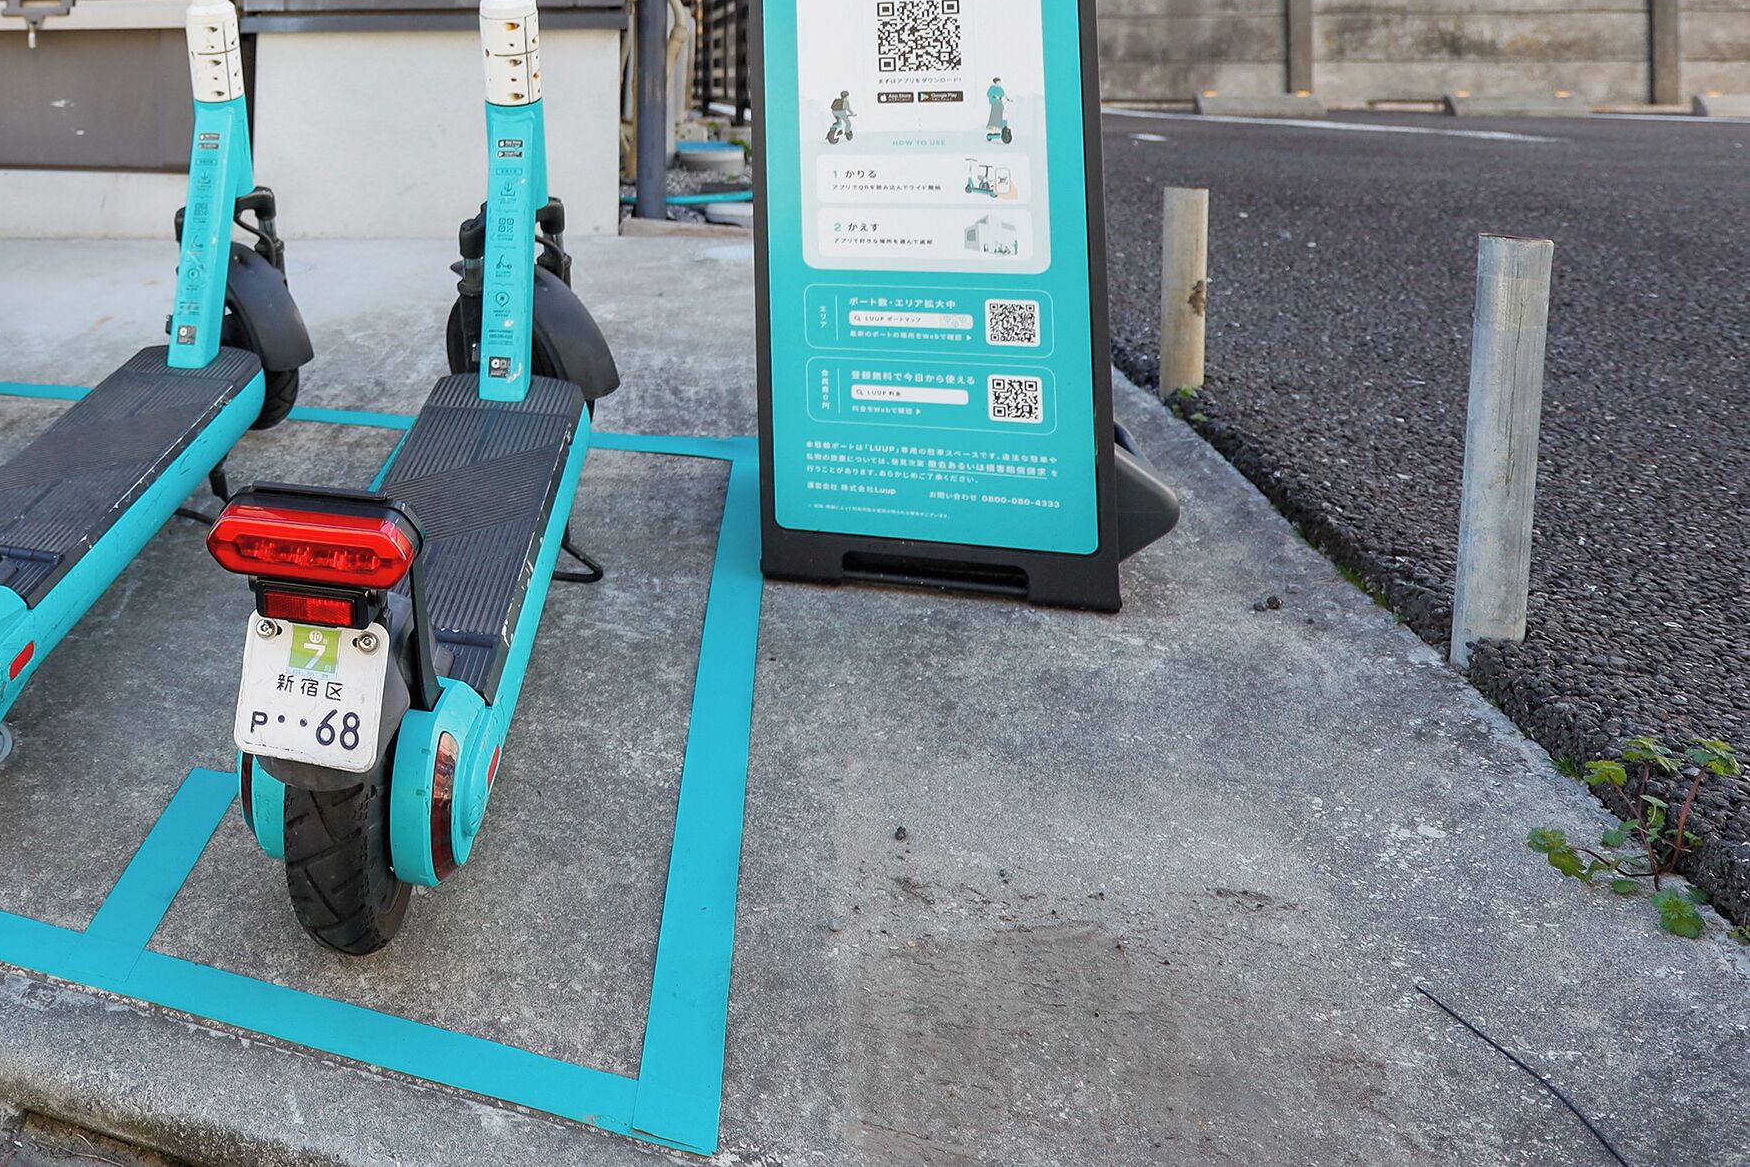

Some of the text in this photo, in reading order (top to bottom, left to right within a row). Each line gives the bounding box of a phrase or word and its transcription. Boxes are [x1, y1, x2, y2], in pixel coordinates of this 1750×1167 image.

[845, 170, 877, 179] かりる
[834, 222, 879, 232] 2 かえす
[819, 305, 827, 328] エリア
[981, 494, 1060, 508] 0800-080-4333
[303, 642, 326, 669] 7
[276, 673, 344, 702] 新宿区
